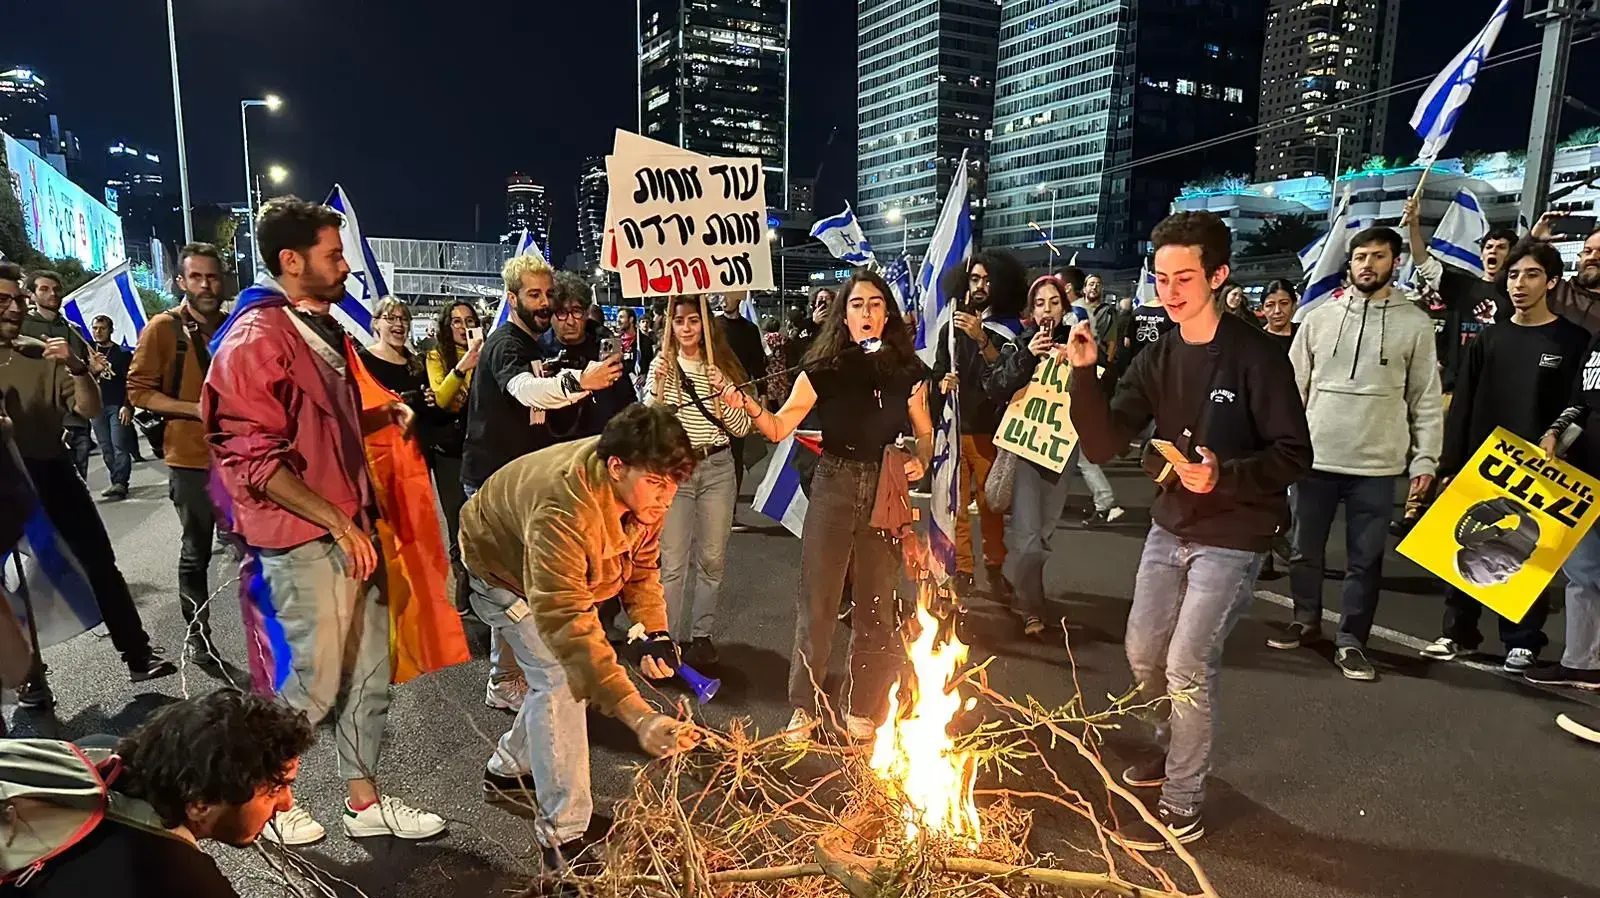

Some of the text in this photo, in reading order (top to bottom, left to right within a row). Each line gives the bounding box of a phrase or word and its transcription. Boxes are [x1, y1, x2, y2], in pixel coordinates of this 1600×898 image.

[634, 164, 759, 203] עוד אחות
[619, 211, 760, 248] אחת ירדה
[627, 252, 752, 293] אל הקבר
[1025, 398, 1062, 432] של
[1494, 438, 1594, 503] אלקטרוני
[1478, 454, 1591, 529] מזיק
